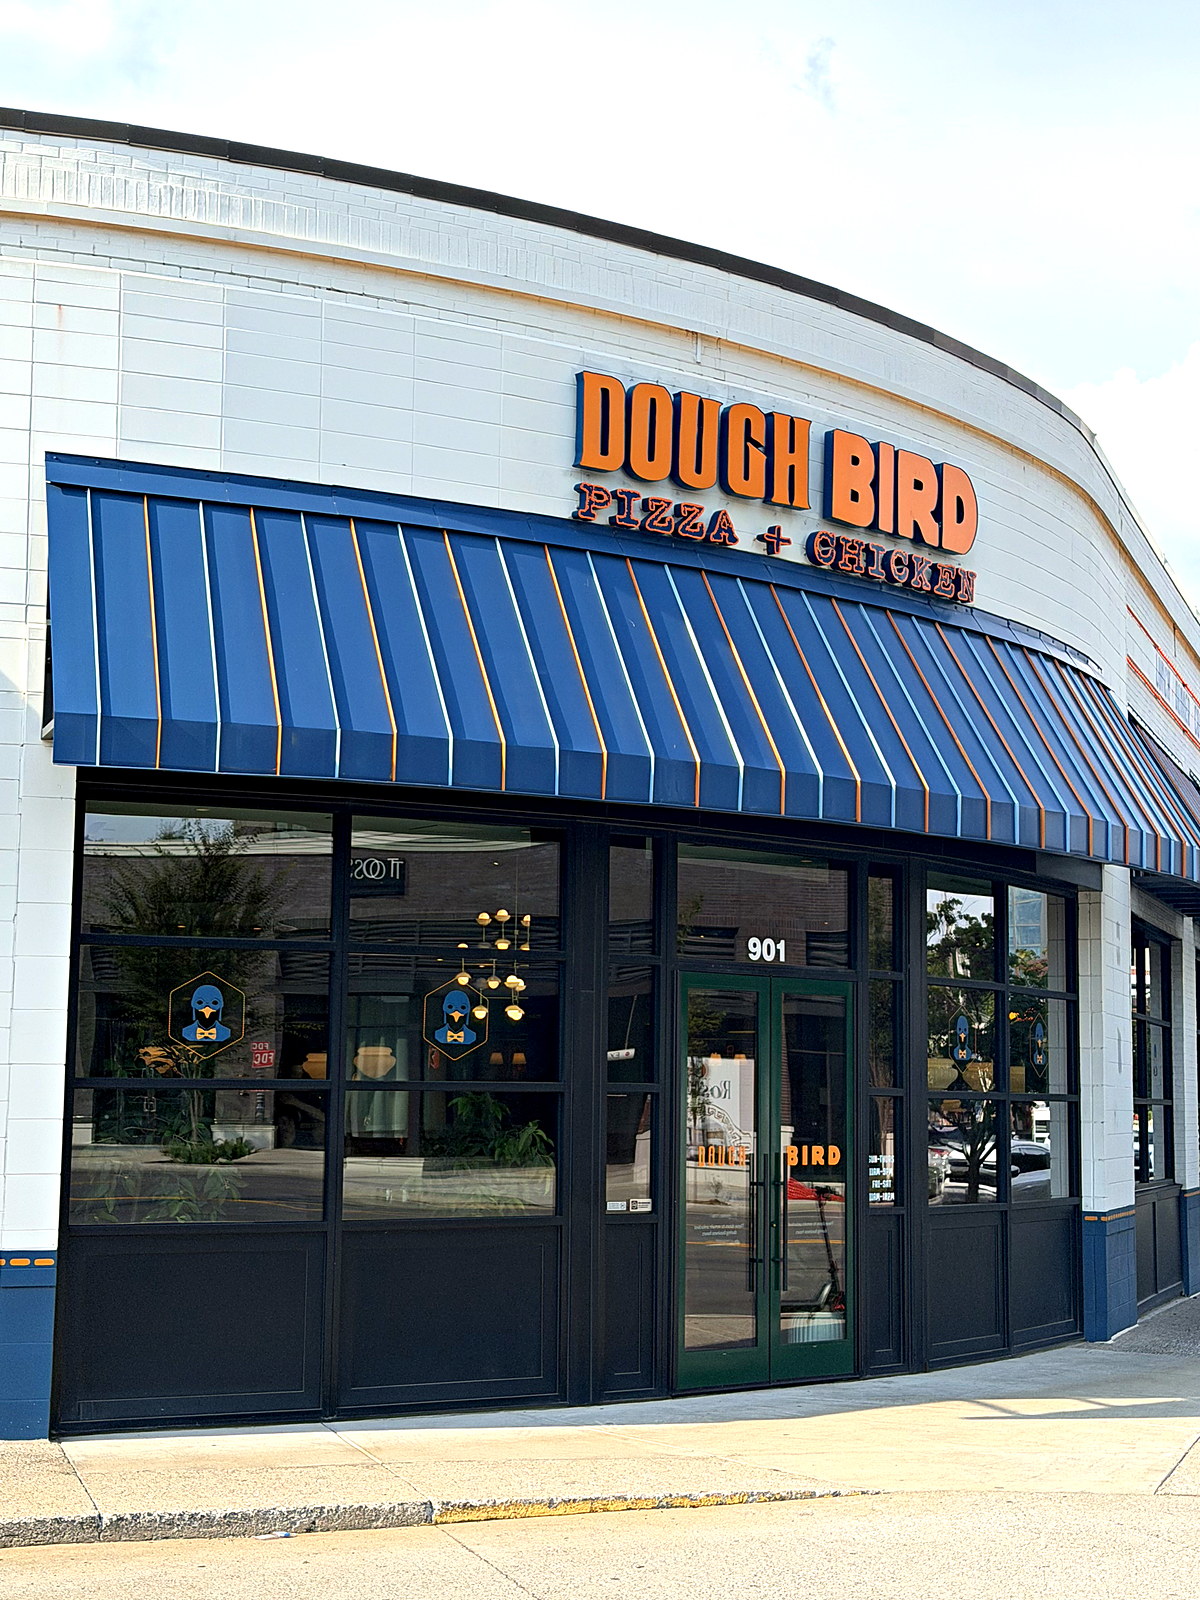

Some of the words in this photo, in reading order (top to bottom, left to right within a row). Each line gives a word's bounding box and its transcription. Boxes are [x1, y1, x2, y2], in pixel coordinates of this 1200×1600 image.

[573, 370, 811, 511] DOUGH
[823, 428, 979, 556] BIRD
[572, 482, 740, 546] PIZZA
[806, 530, 978, 604] CHICKEN
[747, 936, 786, 963] 901
[697, 1144, 747, 1168] DOUGH
[786, 1144, 841, 1166] BIRD
[871, 1179, 892, 1189] FRI-SAT
